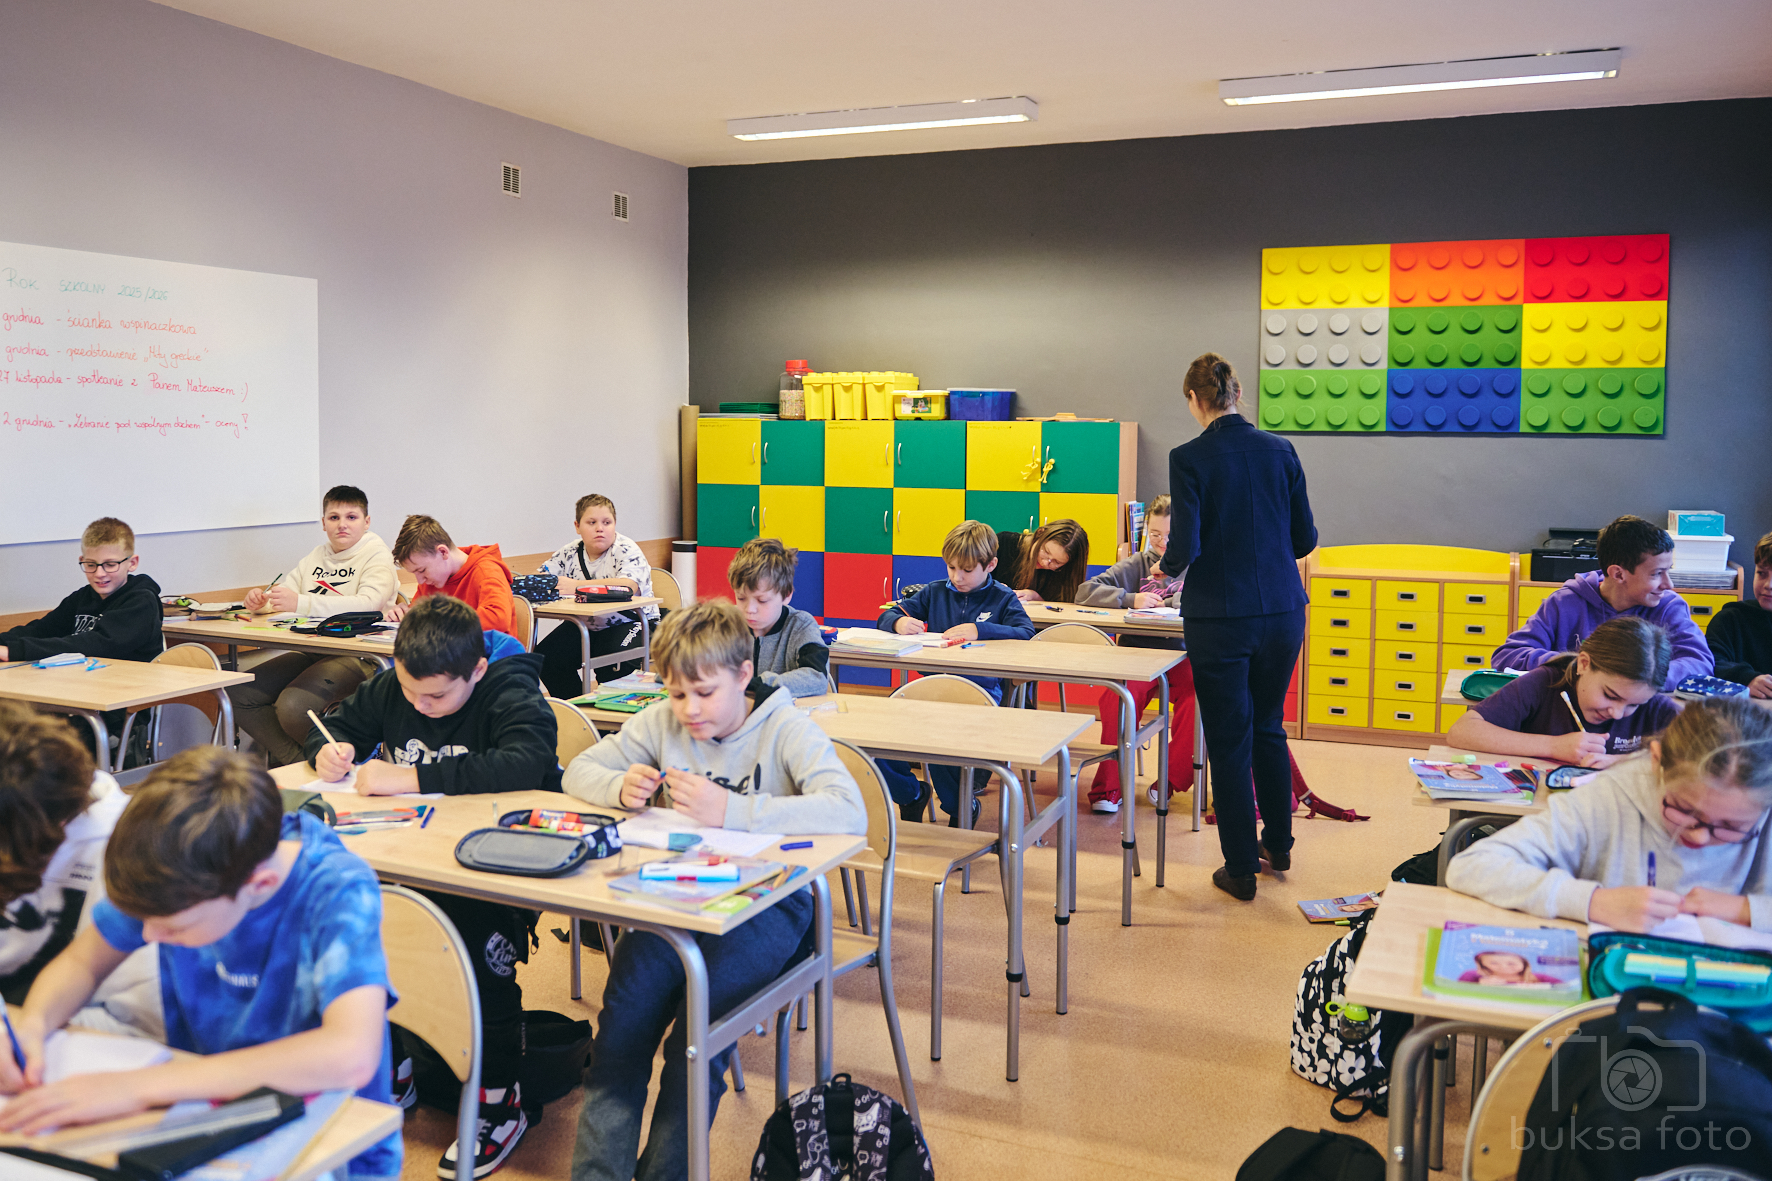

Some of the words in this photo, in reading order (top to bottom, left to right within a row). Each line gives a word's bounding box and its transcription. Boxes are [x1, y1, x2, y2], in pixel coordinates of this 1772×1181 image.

[59, 280, 105, 294] SZKOLNY
[118, 285, 168, 302] 2025/2026
[2, 307, 44, 331] grudnia
[67, 309, 112, 329] ścianka
[120, 318, 197, 335] wspinaczkowa
[5, 342, 49, 362] grudnia
[65, 343, 137, 361] przedstawienie
[16, 369, 63, 389] listopada
[77, 369, 123, 388] spotkanie
[148, 372, 181, 391] Panem
[187, 377, 235, 395] Mateuszem
[3, 411, 11, 425] 2
[15, 414, 55, 431] grudnia
[115, 419, 131, 433] pod
[312, 566, 356, 580] Rebok
